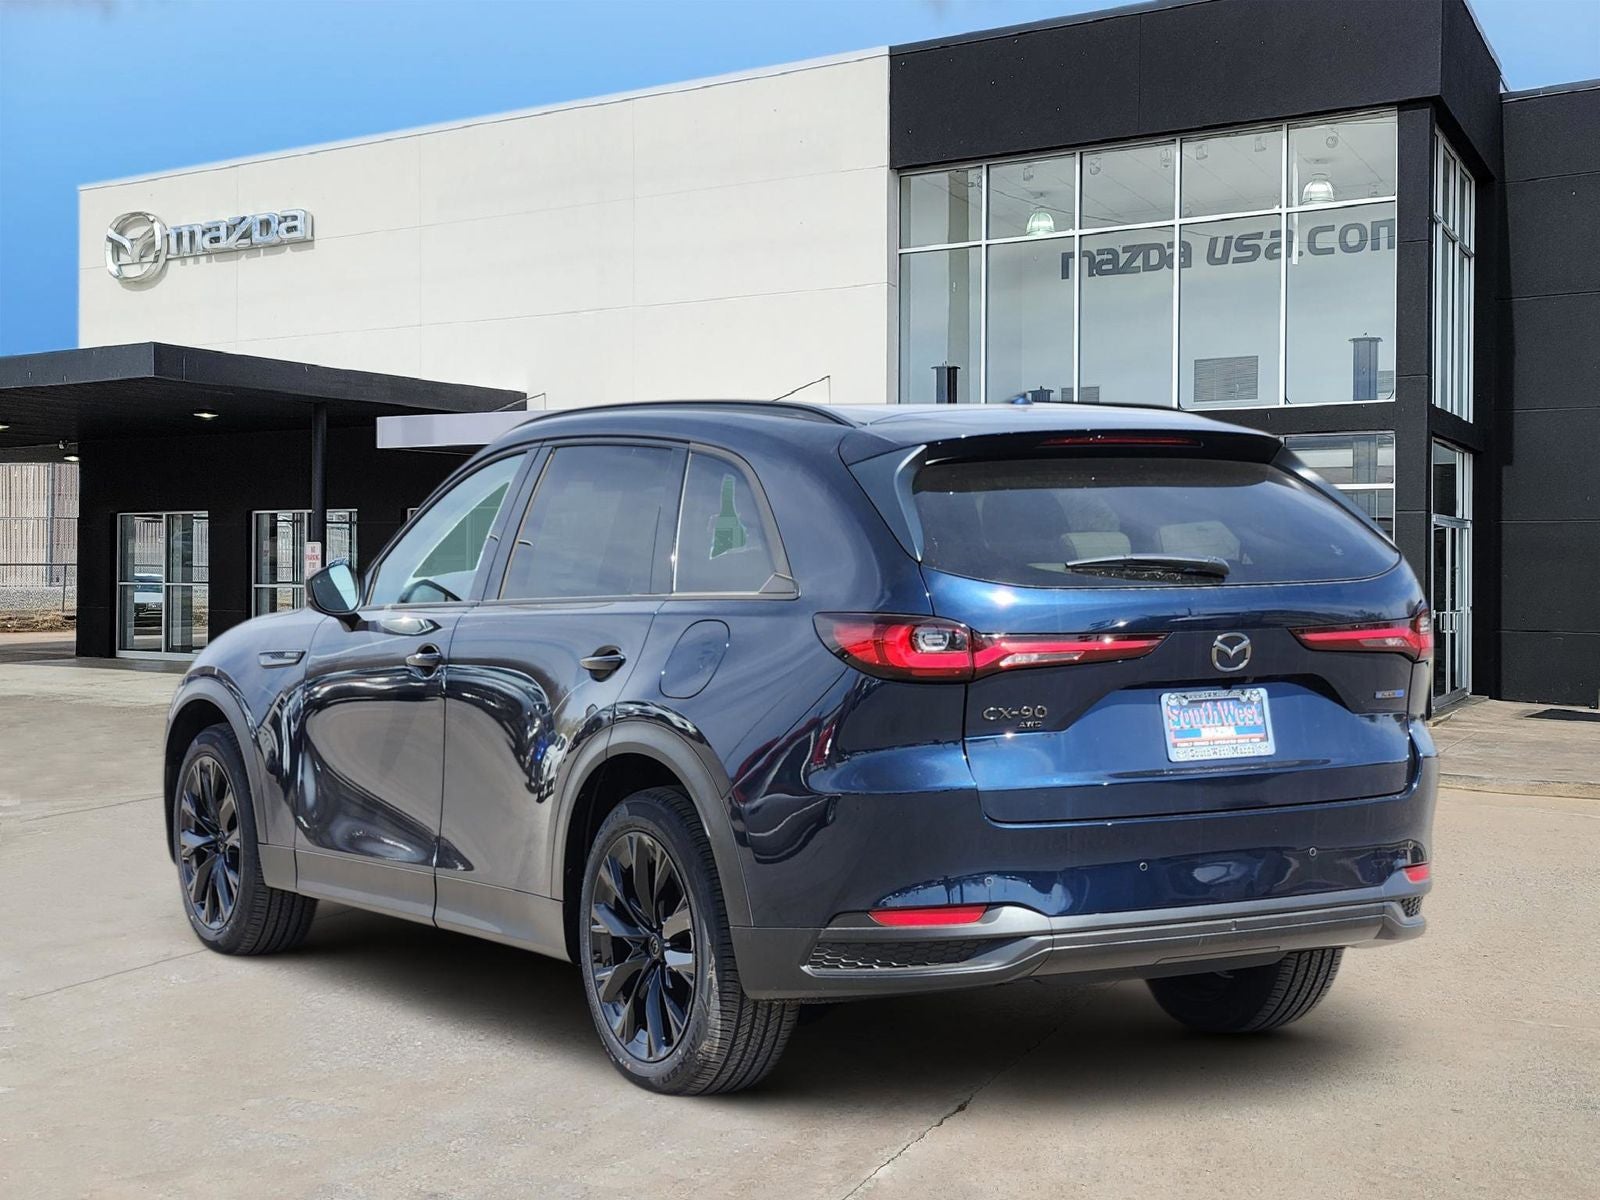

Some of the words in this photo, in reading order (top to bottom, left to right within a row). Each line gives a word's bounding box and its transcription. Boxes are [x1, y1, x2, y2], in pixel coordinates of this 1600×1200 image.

[166, 209, 313, 256] mazda
[983, 706, 1048, 720] CX-90
[1019, 720, 1043, 728] AWD
